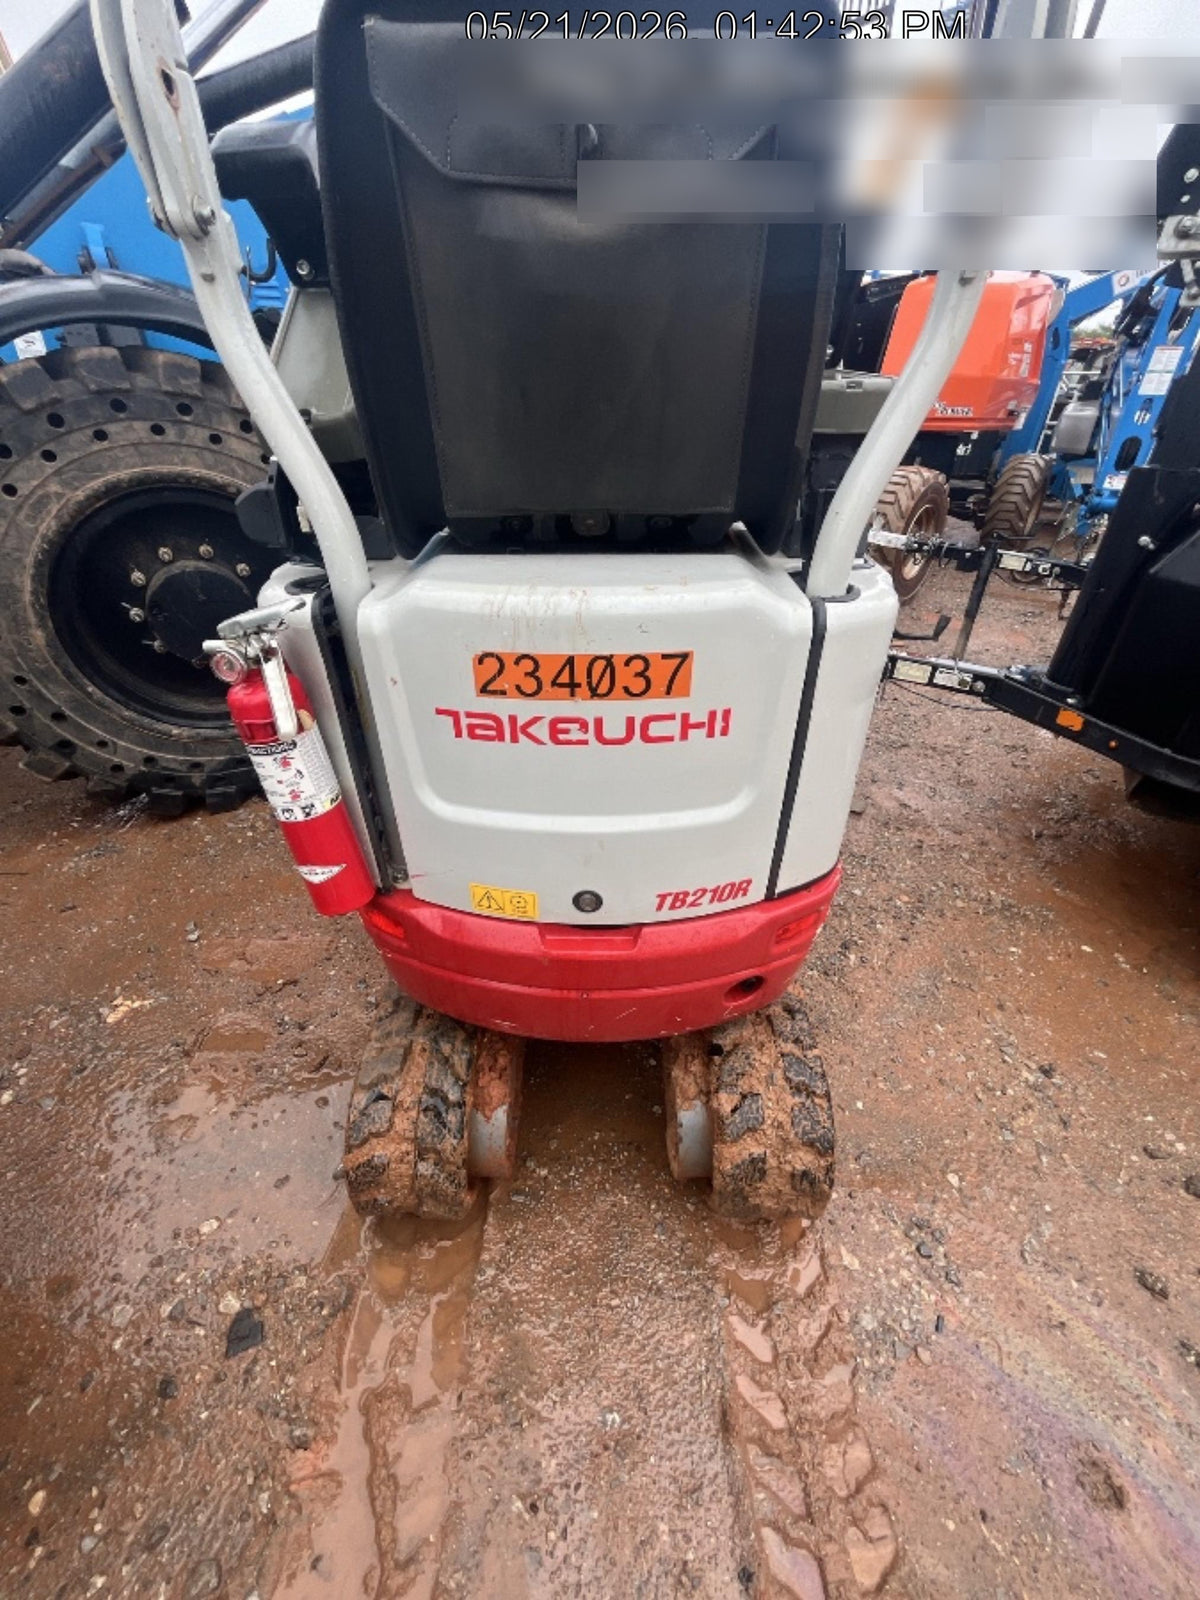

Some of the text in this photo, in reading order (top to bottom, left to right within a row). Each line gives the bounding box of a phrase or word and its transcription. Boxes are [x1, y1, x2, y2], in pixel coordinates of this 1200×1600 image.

[476, 652, 691, 699] 234037
[435, 707, 732, 745] TAKEUCHI
[655, 878, 753, 912] TB210R
